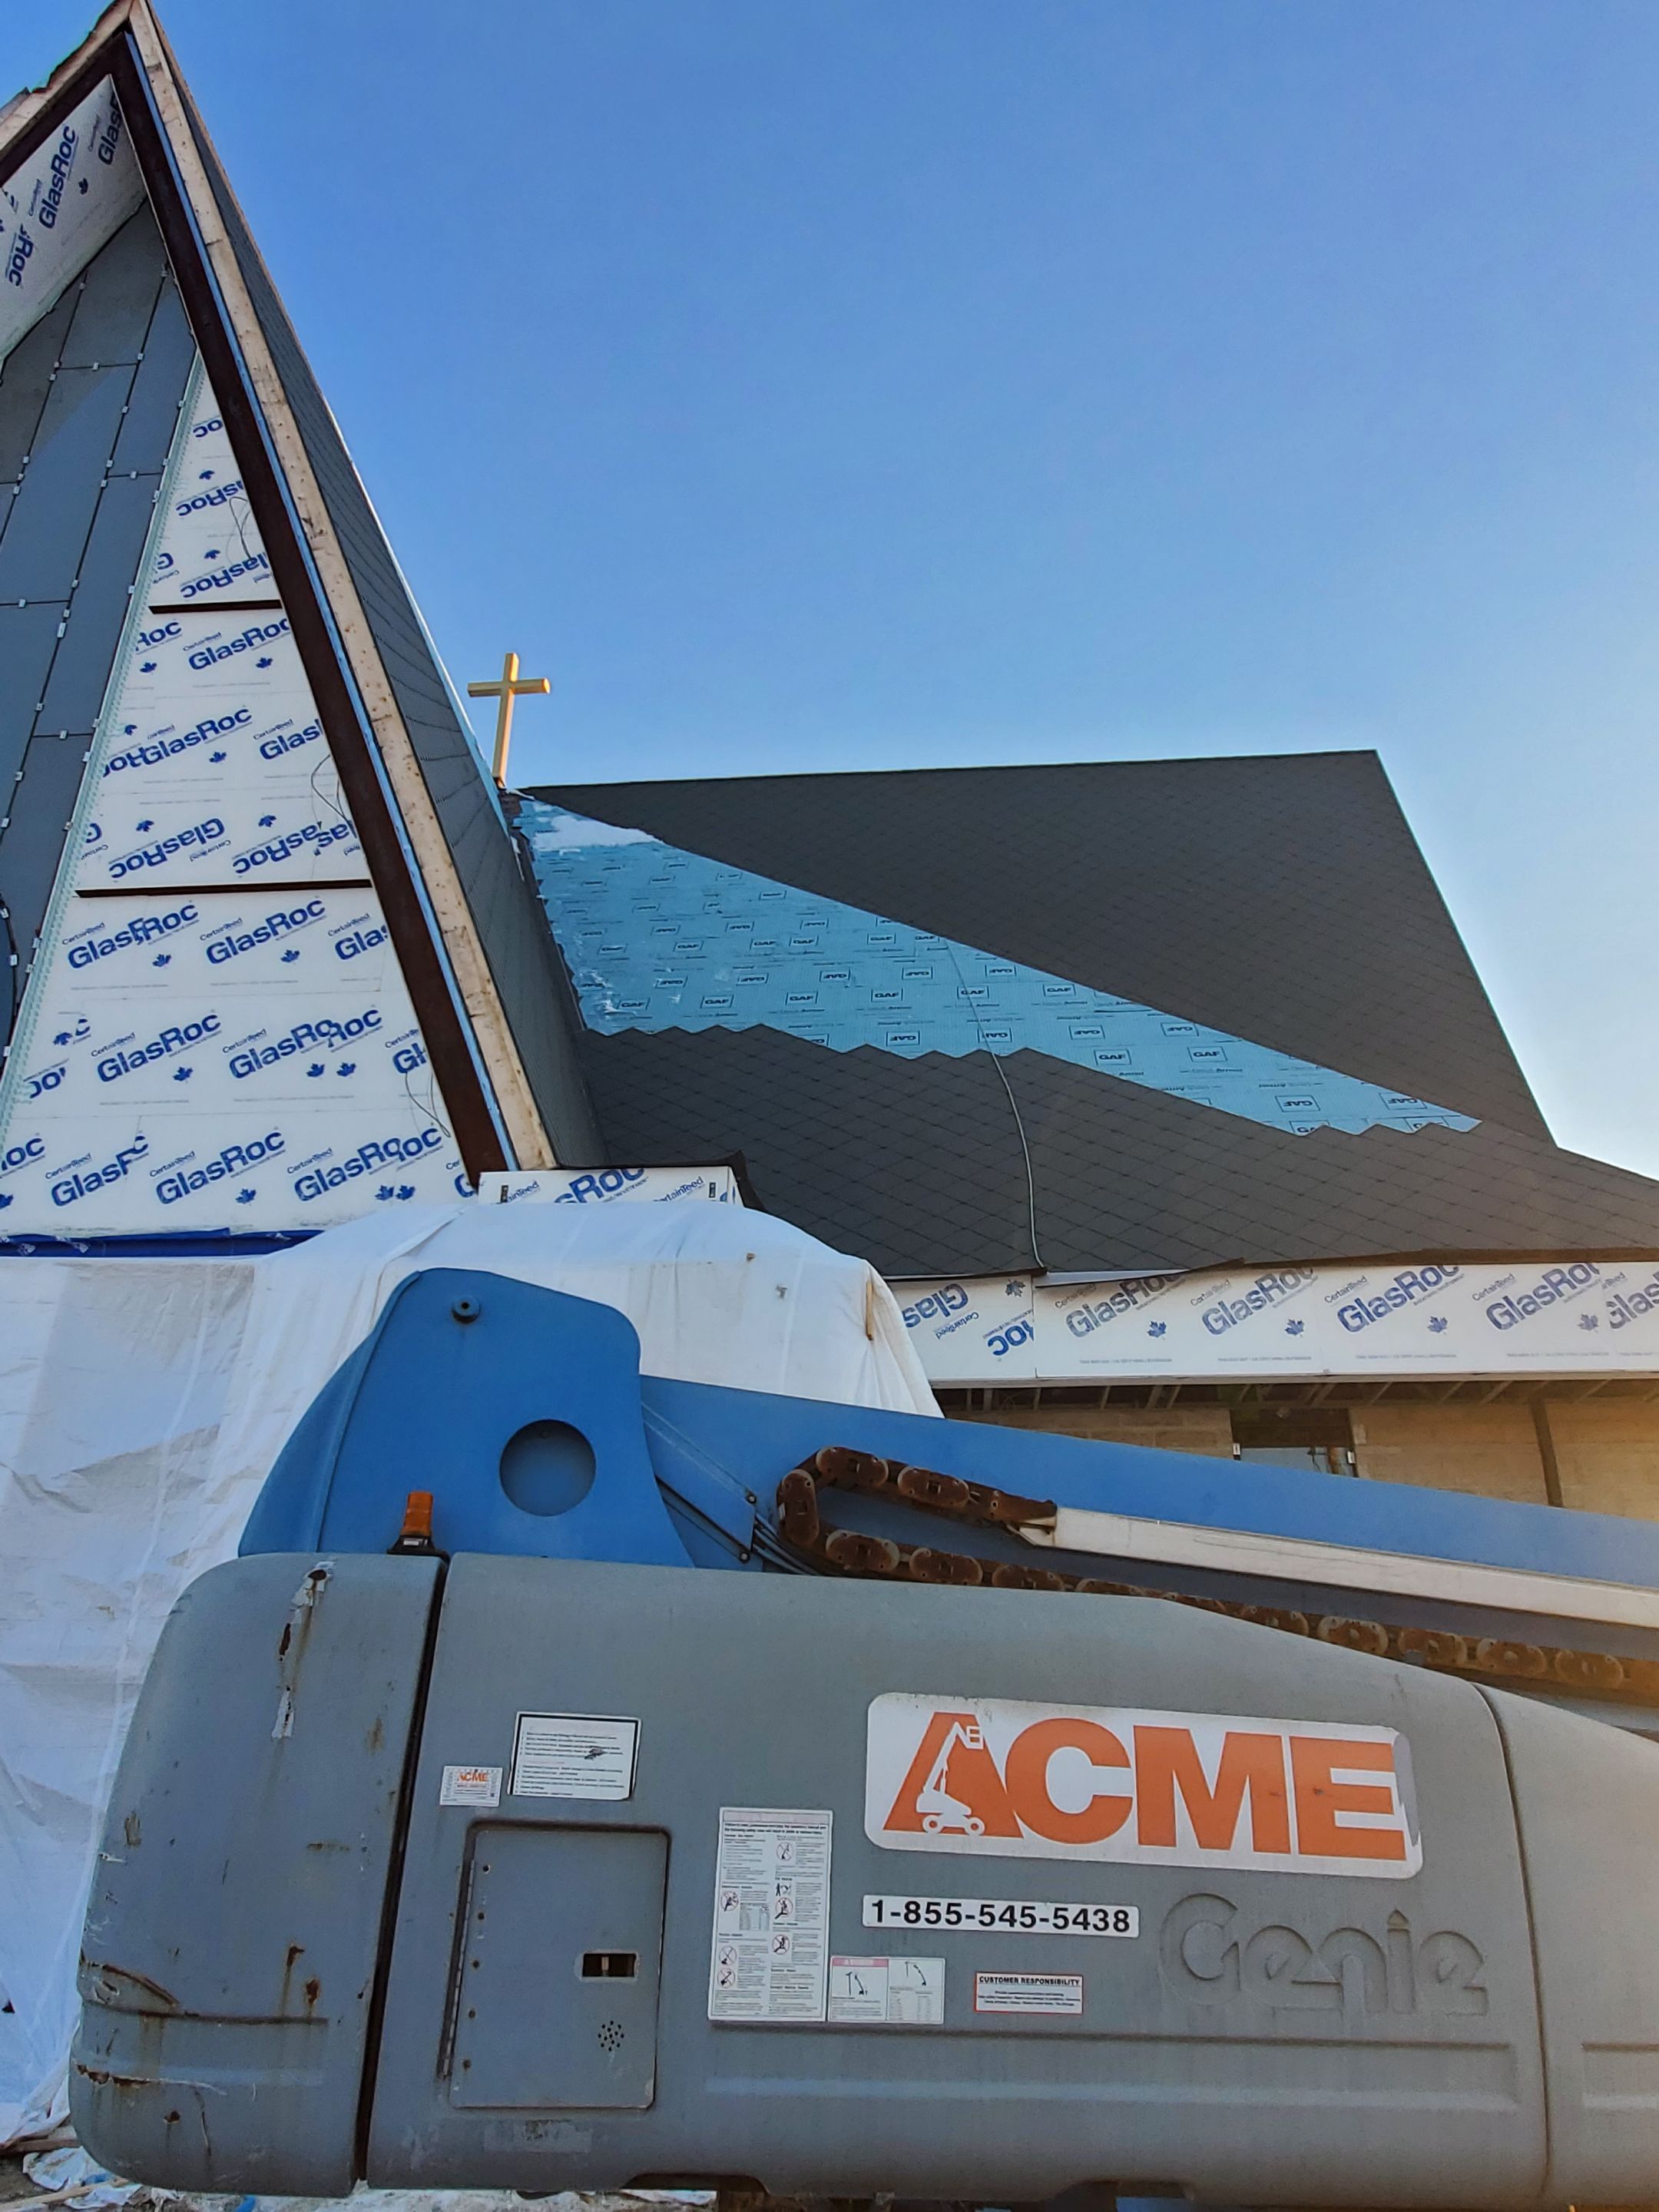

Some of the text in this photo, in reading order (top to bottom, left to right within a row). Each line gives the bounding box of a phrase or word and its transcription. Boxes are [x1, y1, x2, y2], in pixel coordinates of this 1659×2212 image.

[39, 126, 75, 229] GlasRoc
[108, 818, 225, 878] GlasRoc
[206, 899, 326, 965] GlasRoc
[97, 1014, 221, 1082] GlasRoc
[156, 1132, 285, 1204] GlasRoc
[1325, 1276, 1367, 1303] CertainTeed
[1337, 1265, 1459, 1333] GlasRoc
[1472, 1273, 1515, 1301] CertainTeed
[458, 1772, 489, 1782] ACME
[883, 1712, 1406, 1861] ACME
[872, 1899, 1131, 1933] 1-855-545-5438
[979, 1975, 1079, 1985] CUSTOMER RESPONSIBILITY
[1160, 1892, 1488, 2015] Genie
